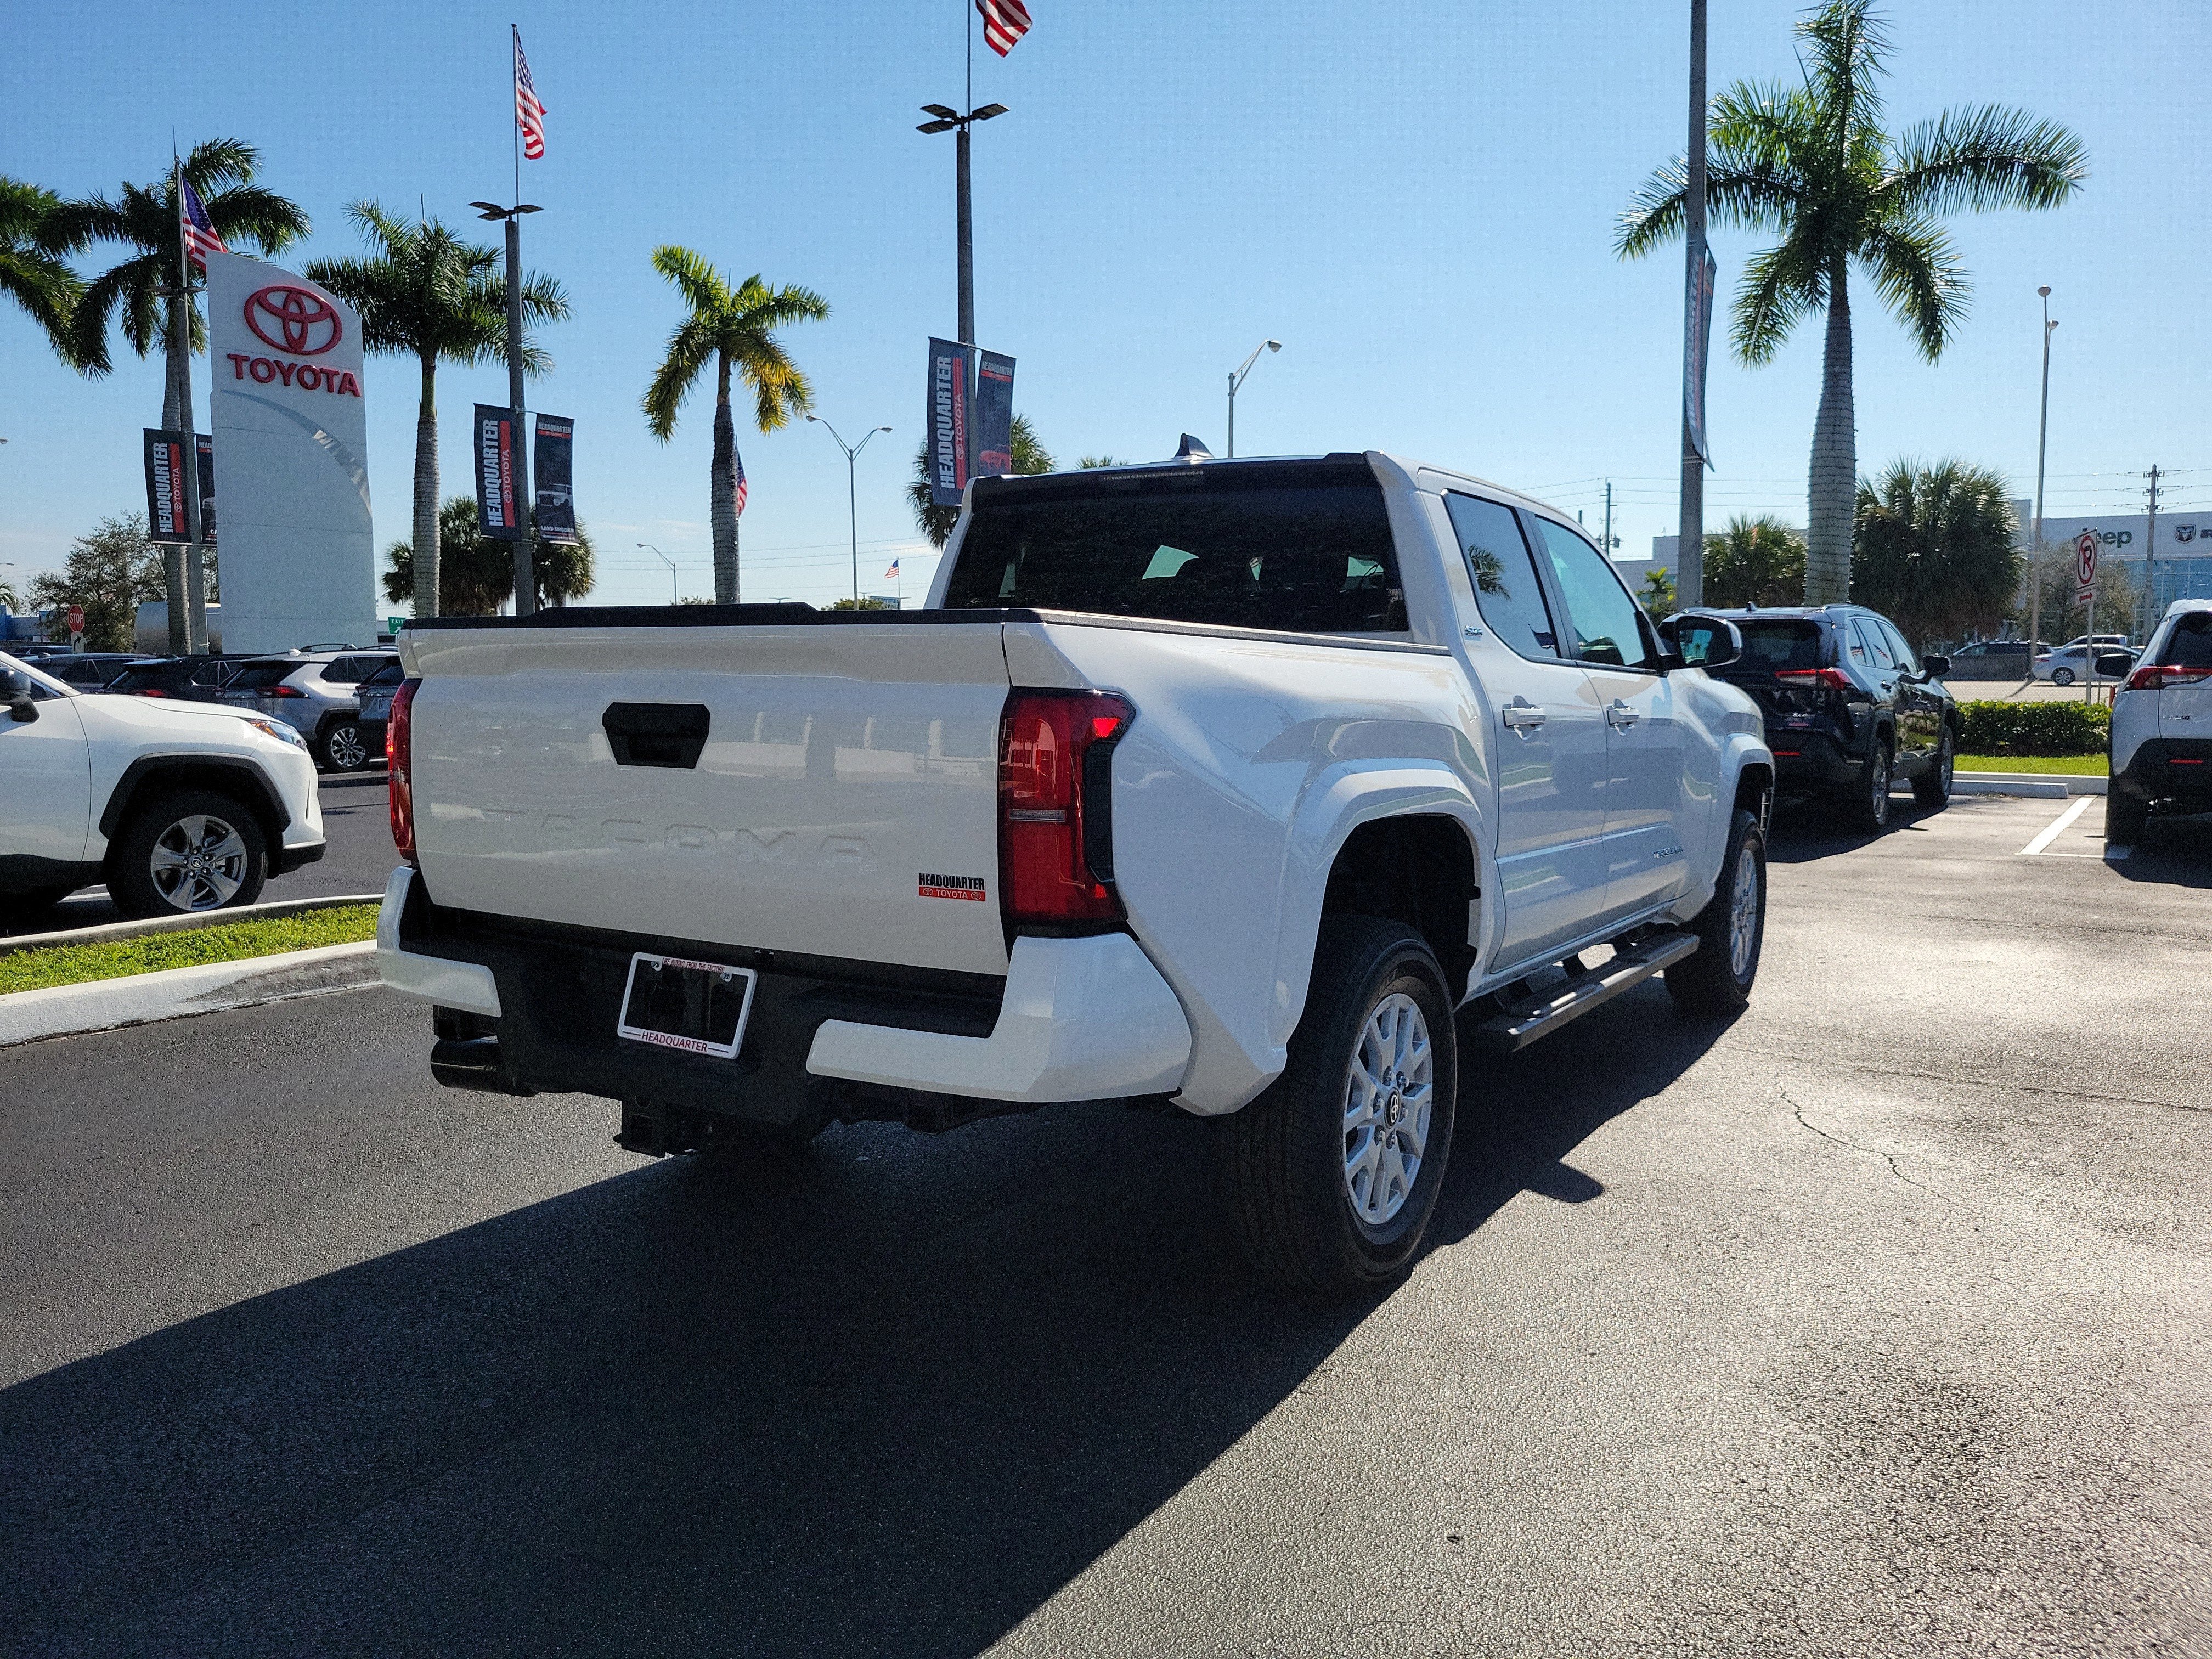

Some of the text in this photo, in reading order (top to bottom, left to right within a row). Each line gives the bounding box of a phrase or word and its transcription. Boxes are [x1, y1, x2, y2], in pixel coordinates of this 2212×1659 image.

[227, 353, 361, 397] TOYOTA
[936, 356, 956, 489] HEADQUARTER
[955, 394, 964, 445] TOYOTA
[153, 442, 173, 533] HEADQUARTER
[173, 467, 182, 501] TOYOTA
[483, 419, 504, 527] HEADQUARTER
[501, 450, 511, 488] TOYOTA
[70, 613, 83, 624] STOP
[481, 808, 877, 871] TACOMA
[919, 873, 985, 890] HEADQUARTER
[936, 889, 968, 899] TOYOTA
[642, 1031, 707, 1052] HEADQUARTER
